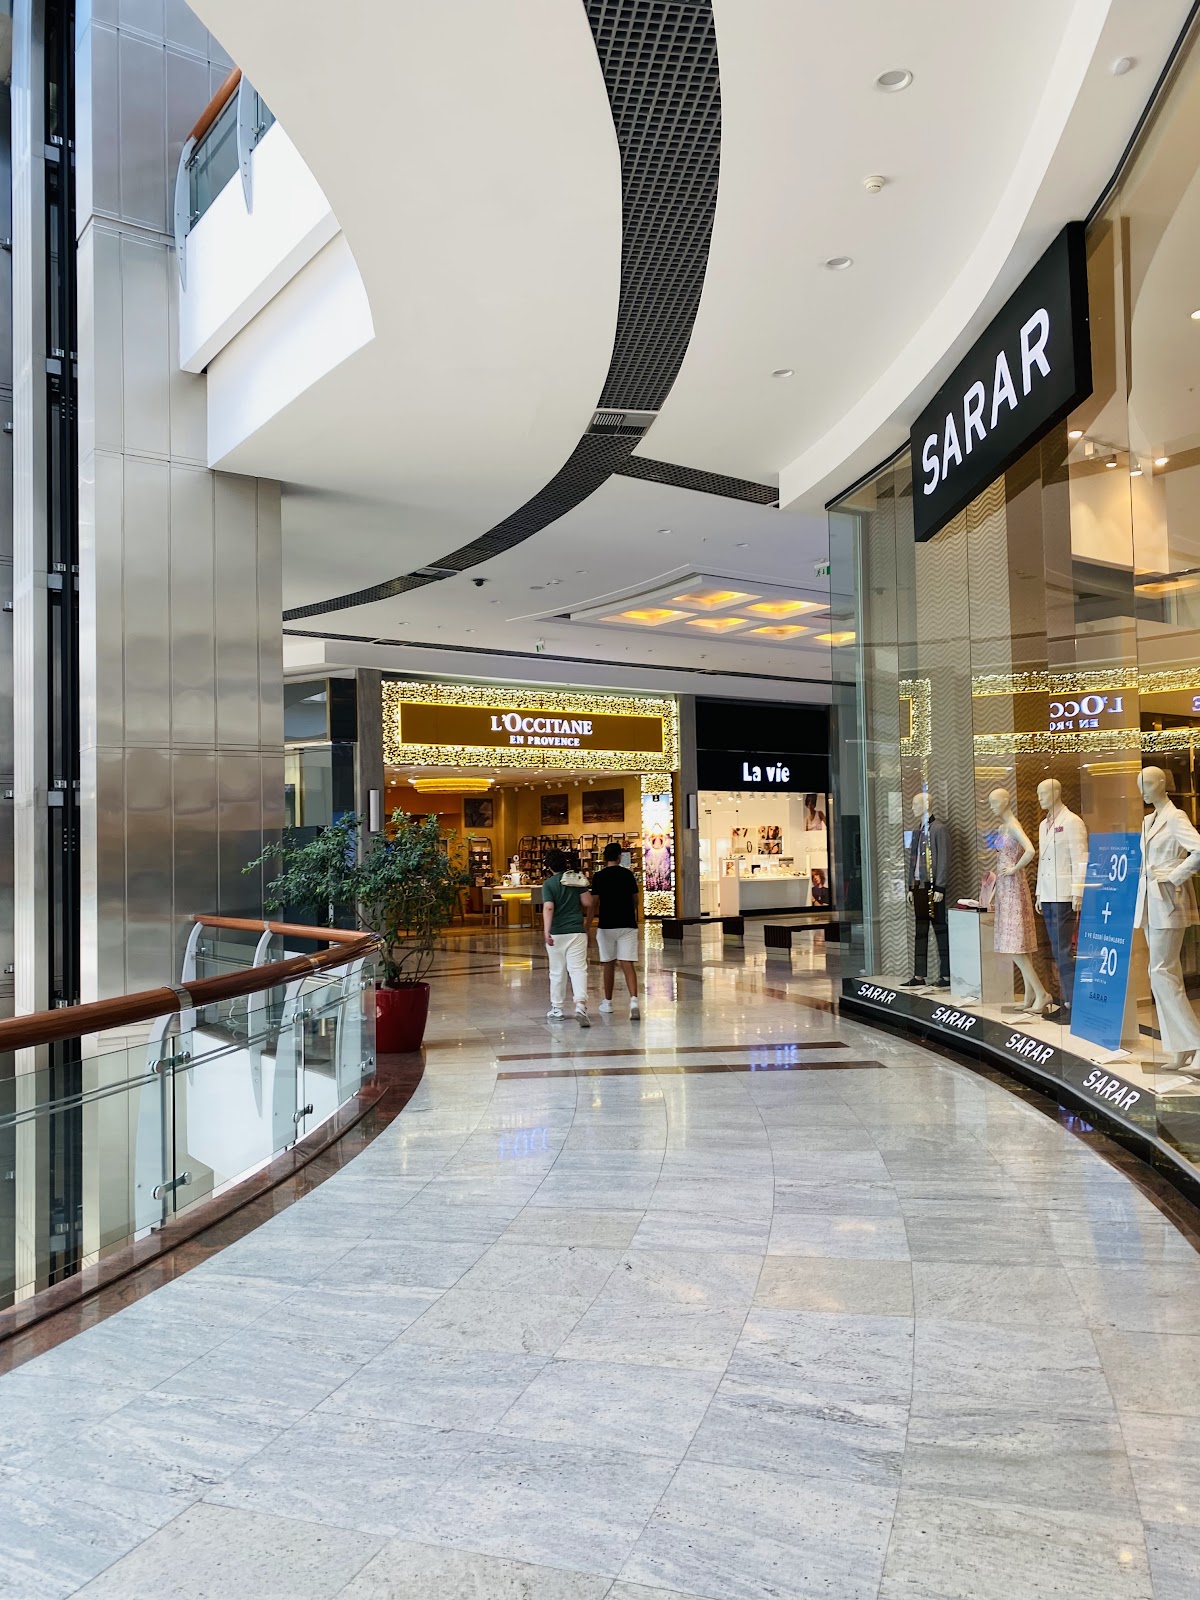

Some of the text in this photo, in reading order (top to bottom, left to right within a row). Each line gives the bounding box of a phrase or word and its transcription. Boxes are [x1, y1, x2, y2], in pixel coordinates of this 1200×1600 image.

[921, 307, 1051, 495] SARAR
[490, 712, 593, 735] L'OCCITANE
[509, 735, 580, 746] EN PROVENCE
[743, 761, 790, 783] La vie
[857, 984, 897, 1005] SARAR
[1088, 991, 1108, 1004] SARAR
[931, 1006, 977, 1031] SARAR
[1005, 1033, 1055, 1065] SARAR
[1082, 1070, 1141, 1111] SARAR
